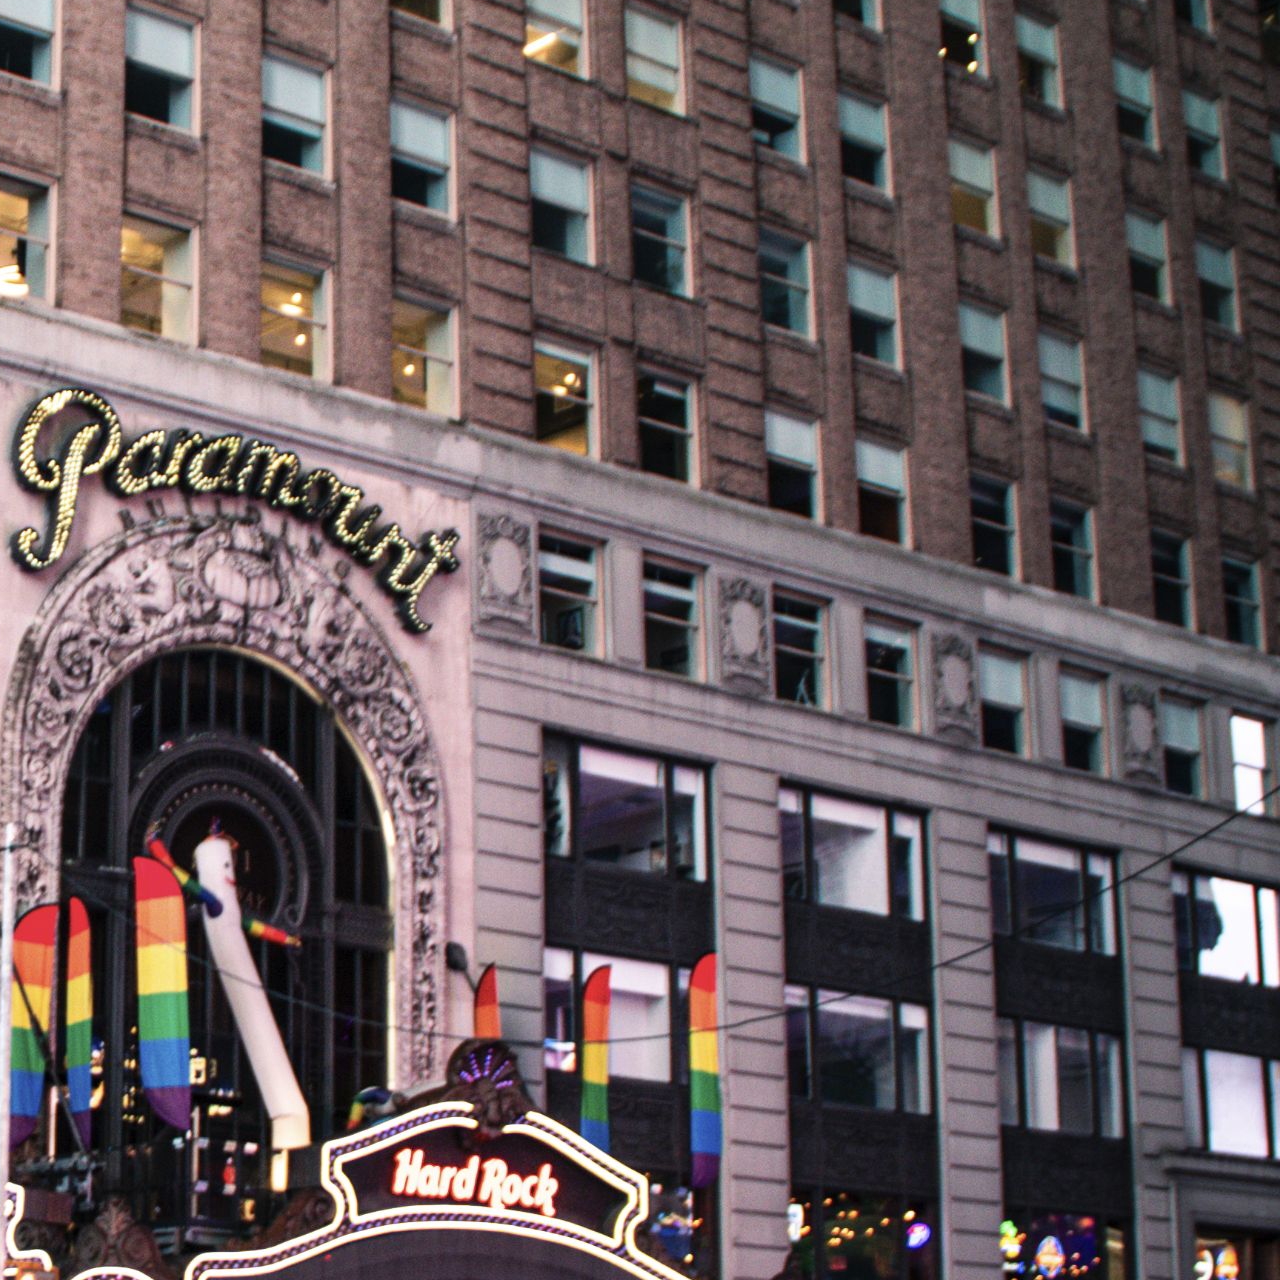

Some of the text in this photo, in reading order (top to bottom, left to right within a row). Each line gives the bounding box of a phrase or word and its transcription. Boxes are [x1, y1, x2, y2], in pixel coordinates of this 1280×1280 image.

[12, 387, 461, 635] Paramount
[392, 1148, 559, 1217] Hard Rock
